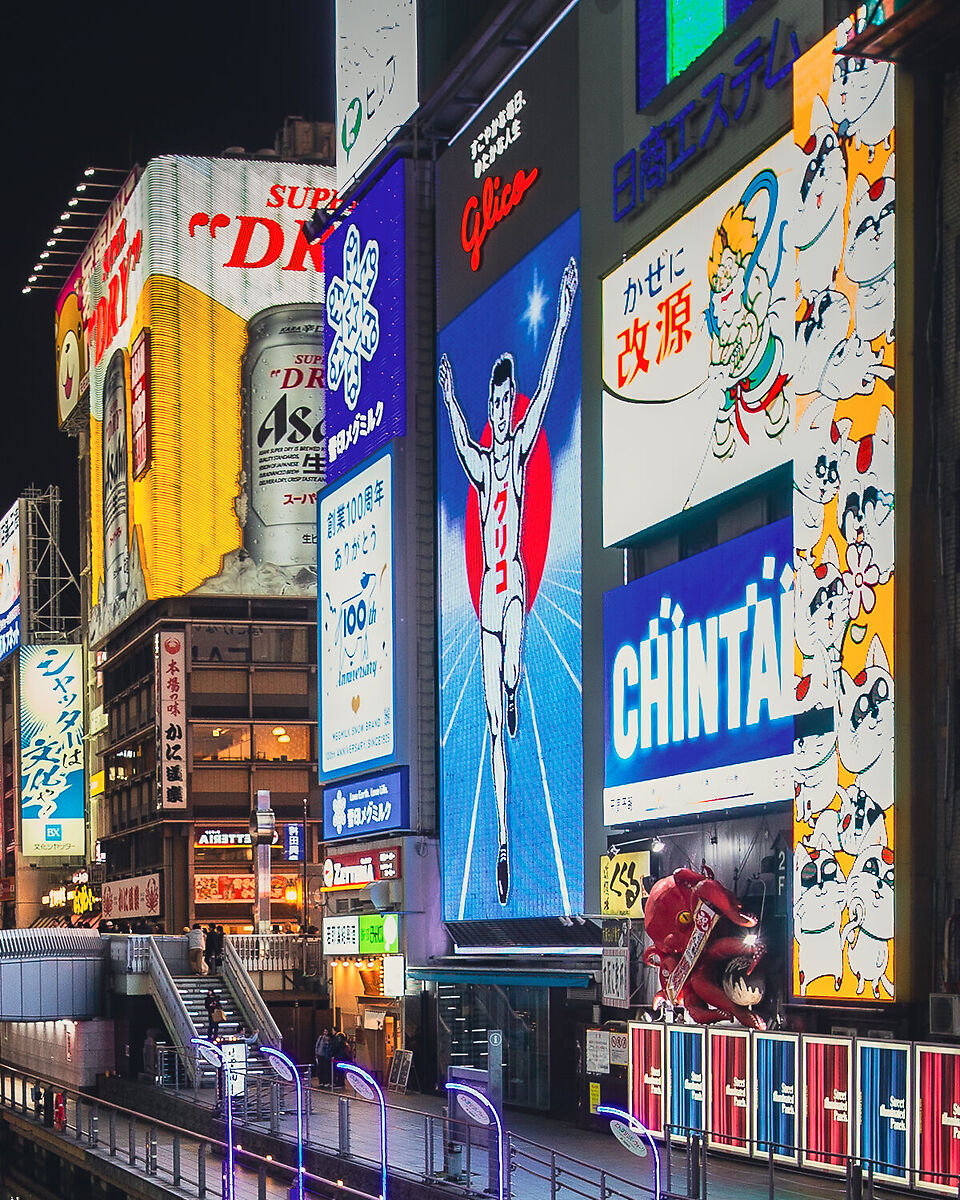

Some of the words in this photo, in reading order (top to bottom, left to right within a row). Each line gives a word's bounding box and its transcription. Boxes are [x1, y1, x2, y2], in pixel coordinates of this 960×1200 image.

[460, 167, 539, 272] Glico
[623, 245, 686, 316] かぜに
[616, 280, 693, 389] 改源
[283, 493, 317, 505] スーパ
[327, 479, 384, 540] 創業100周年
[334, 524, 377, 572] ありがとう
[493, 480, 510, 594] グリコ
[343, 599, 377, 638] 100th
[166, 659, 181, 718] 本場の味
